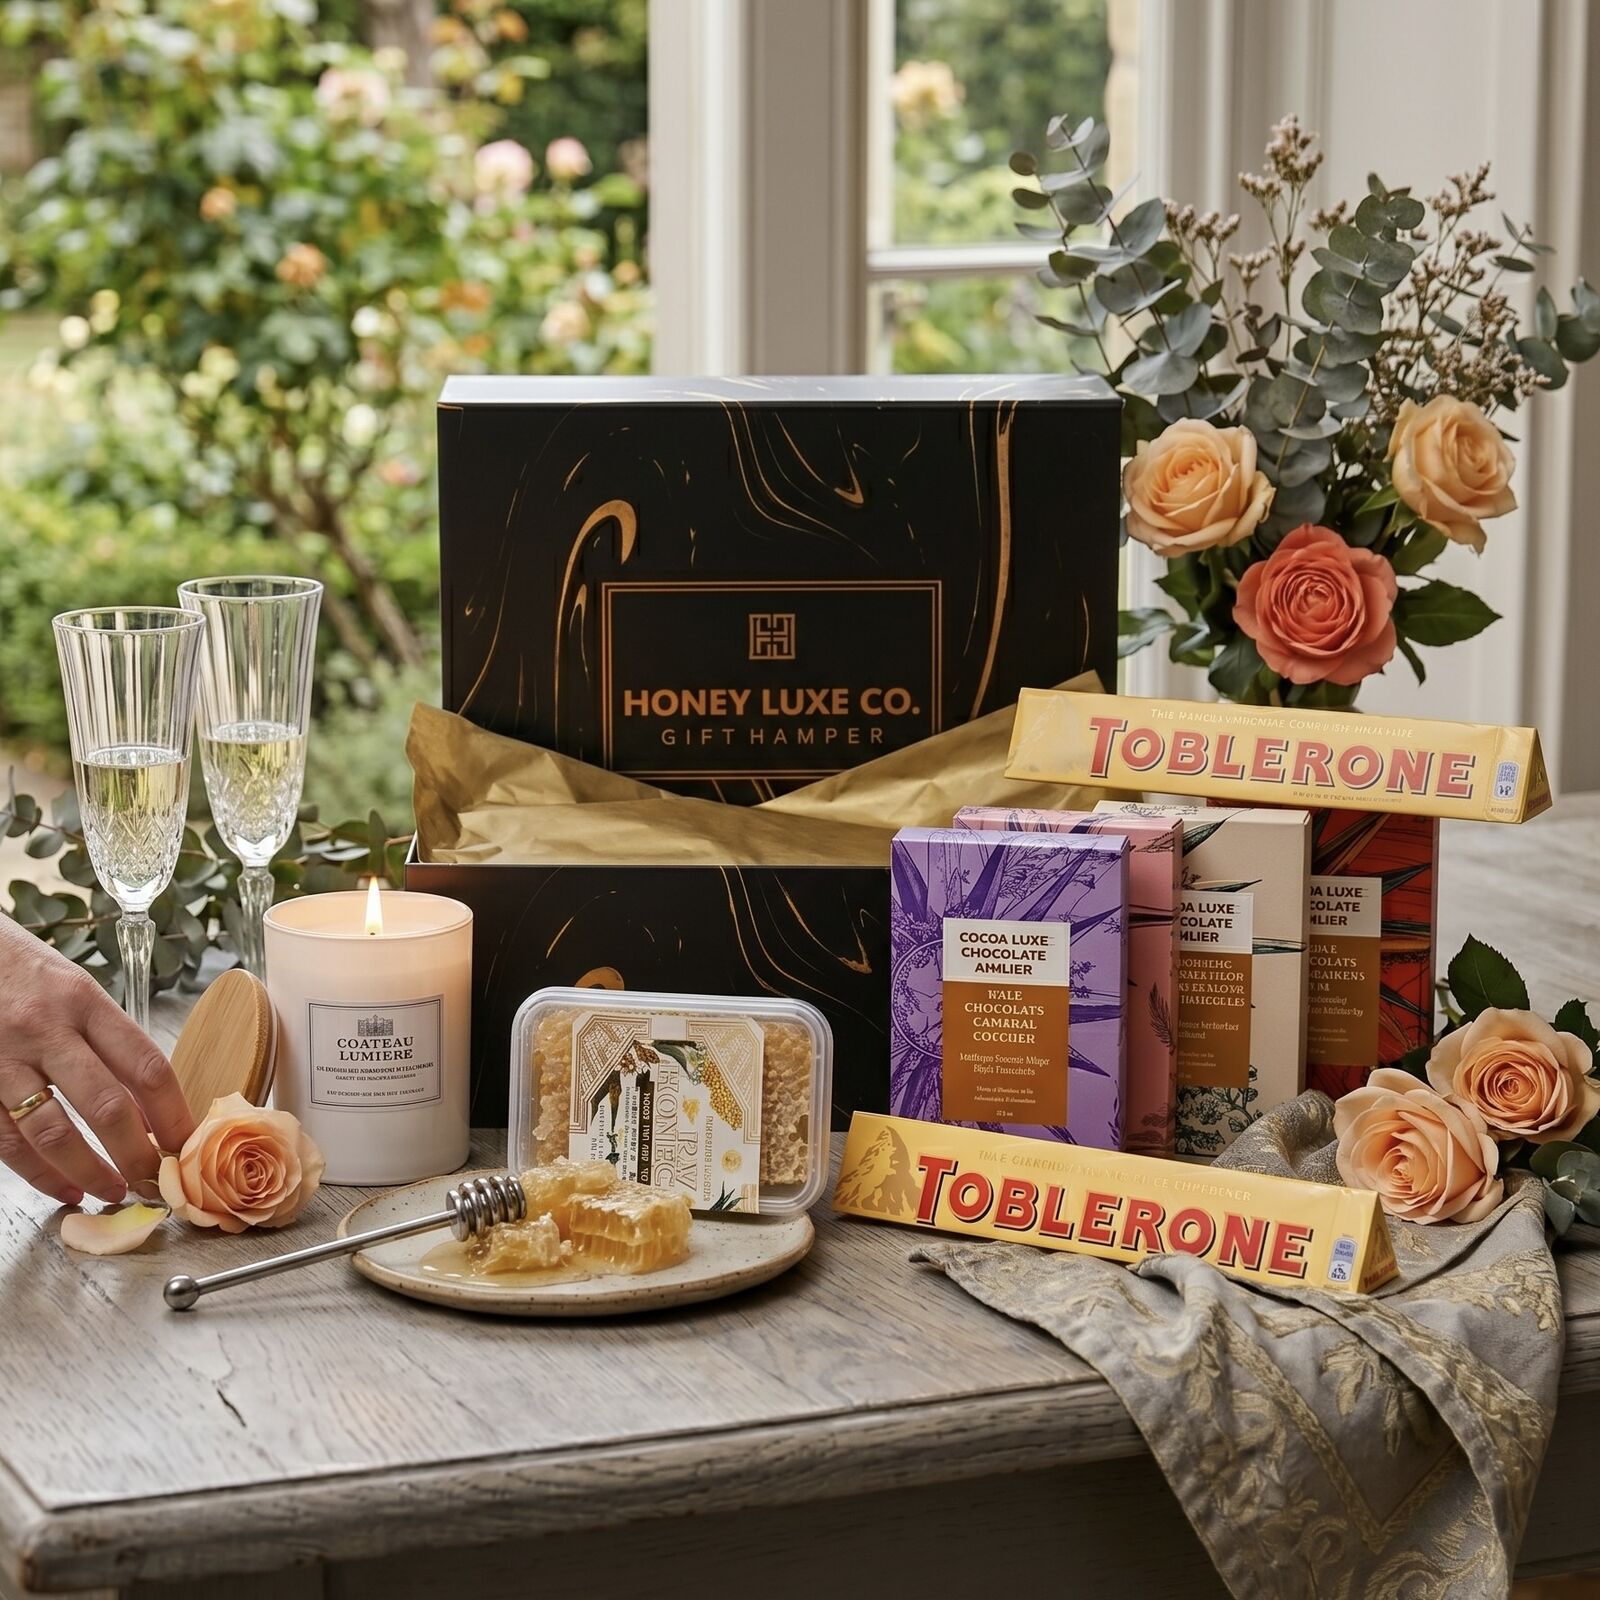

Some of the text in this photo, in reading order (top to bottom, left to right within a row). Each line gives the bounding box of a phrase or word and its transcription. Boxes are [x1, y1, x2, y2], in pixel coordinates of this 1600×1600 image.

[624, 687, 920, 716] HONEY LUXE CO.
[661, 727, 884, 746] GIFT HAMPER
[1088, 716, 1477, 800] TOBLERONE
[1326, 887, 1363, 898] LUXE
[1198, 903, 1235, 914] LUXE
[1310, 901, 1361, 912] COLATE
[1180, 916, 1233, 928] COLATE
[959, 932, 1049, 946] COCOA LUXE
[961, 947, 1046, 961] CHOCOLATE
[1310, 957, 1358, 968] COLATS
[337, 1036, 414, 1049] COATEAU
[339, 1048, 413, 1061] LUMIERE
[914, 1155, 1315, 1278] TOBLERONE
